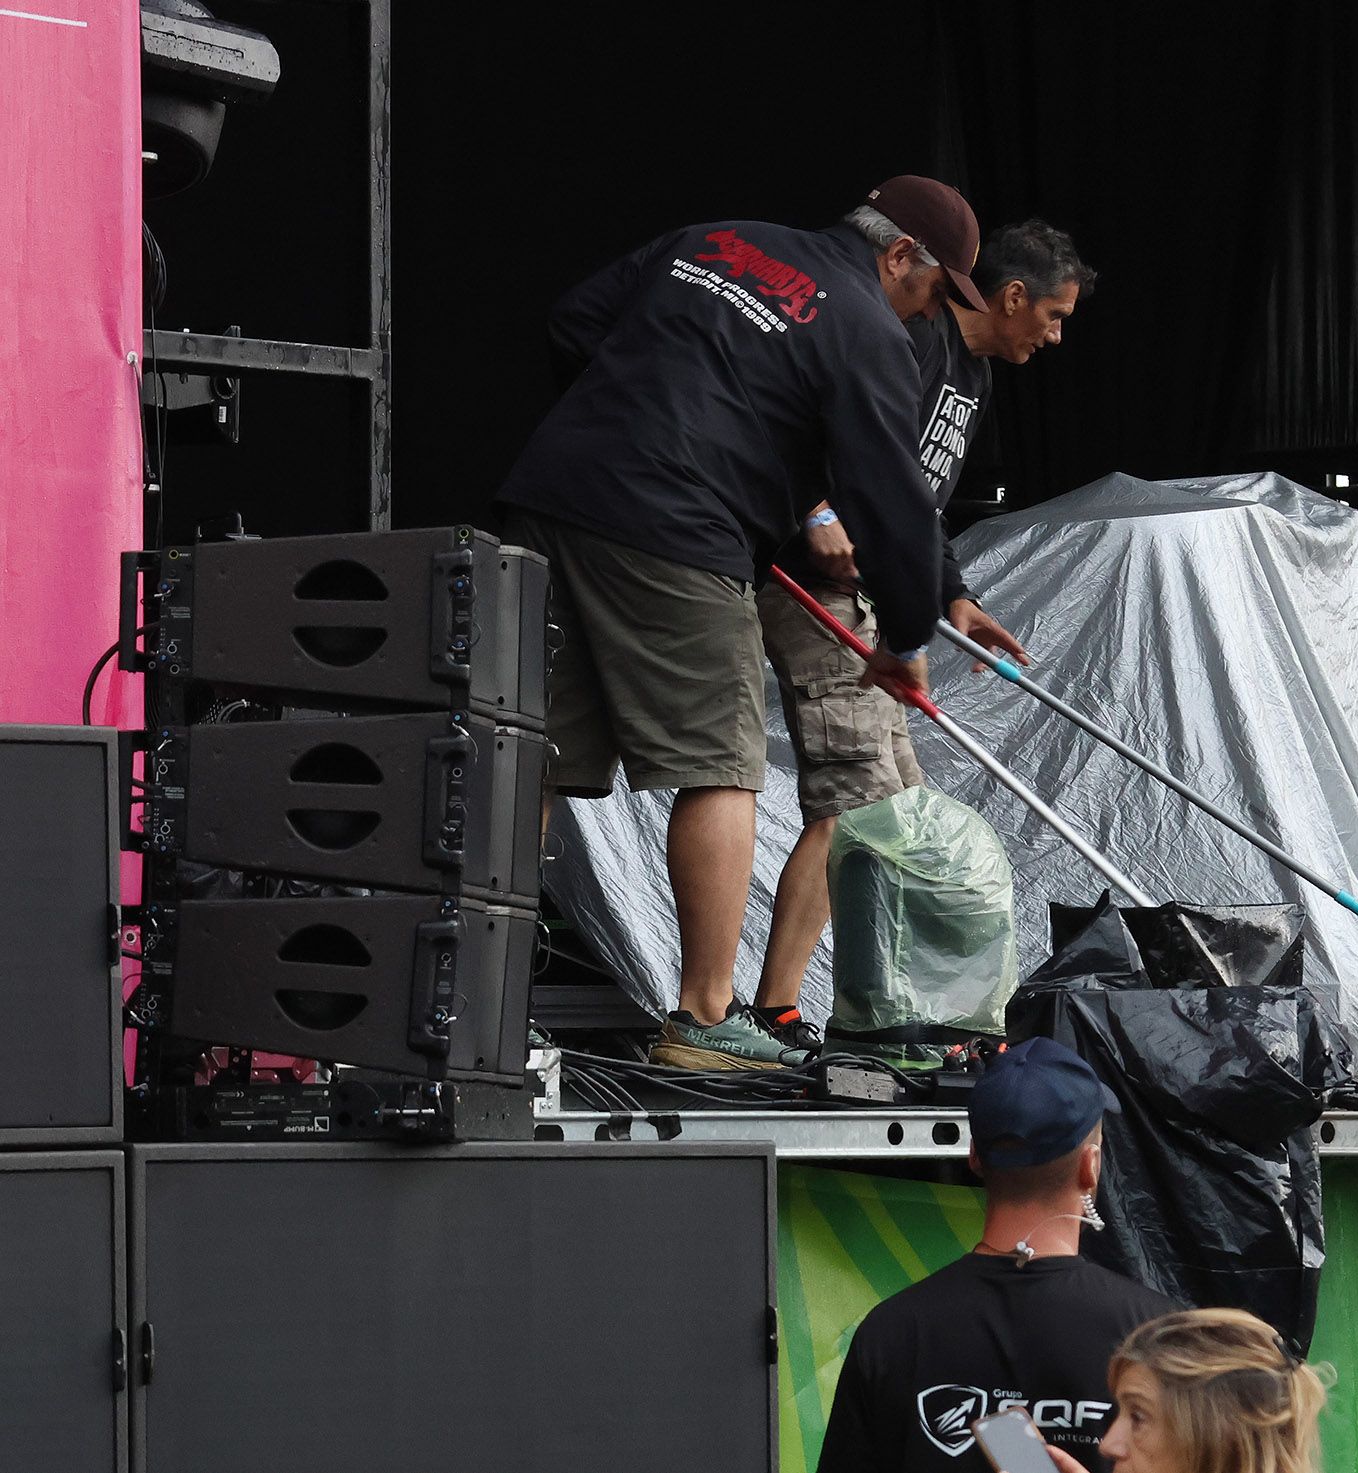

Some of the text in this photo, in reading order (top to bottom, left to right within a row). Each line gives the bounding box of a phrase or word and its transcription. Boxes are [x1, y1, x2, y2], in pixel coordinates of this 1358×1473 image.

[670, 268, 721, 296] DETROIT,
[672, 258, 788, 333] WORK IN PROGRESS
[993, 1388, 1022, 1399] Grupo
[1053, 1434, 1104, 1445] INTEGRA
